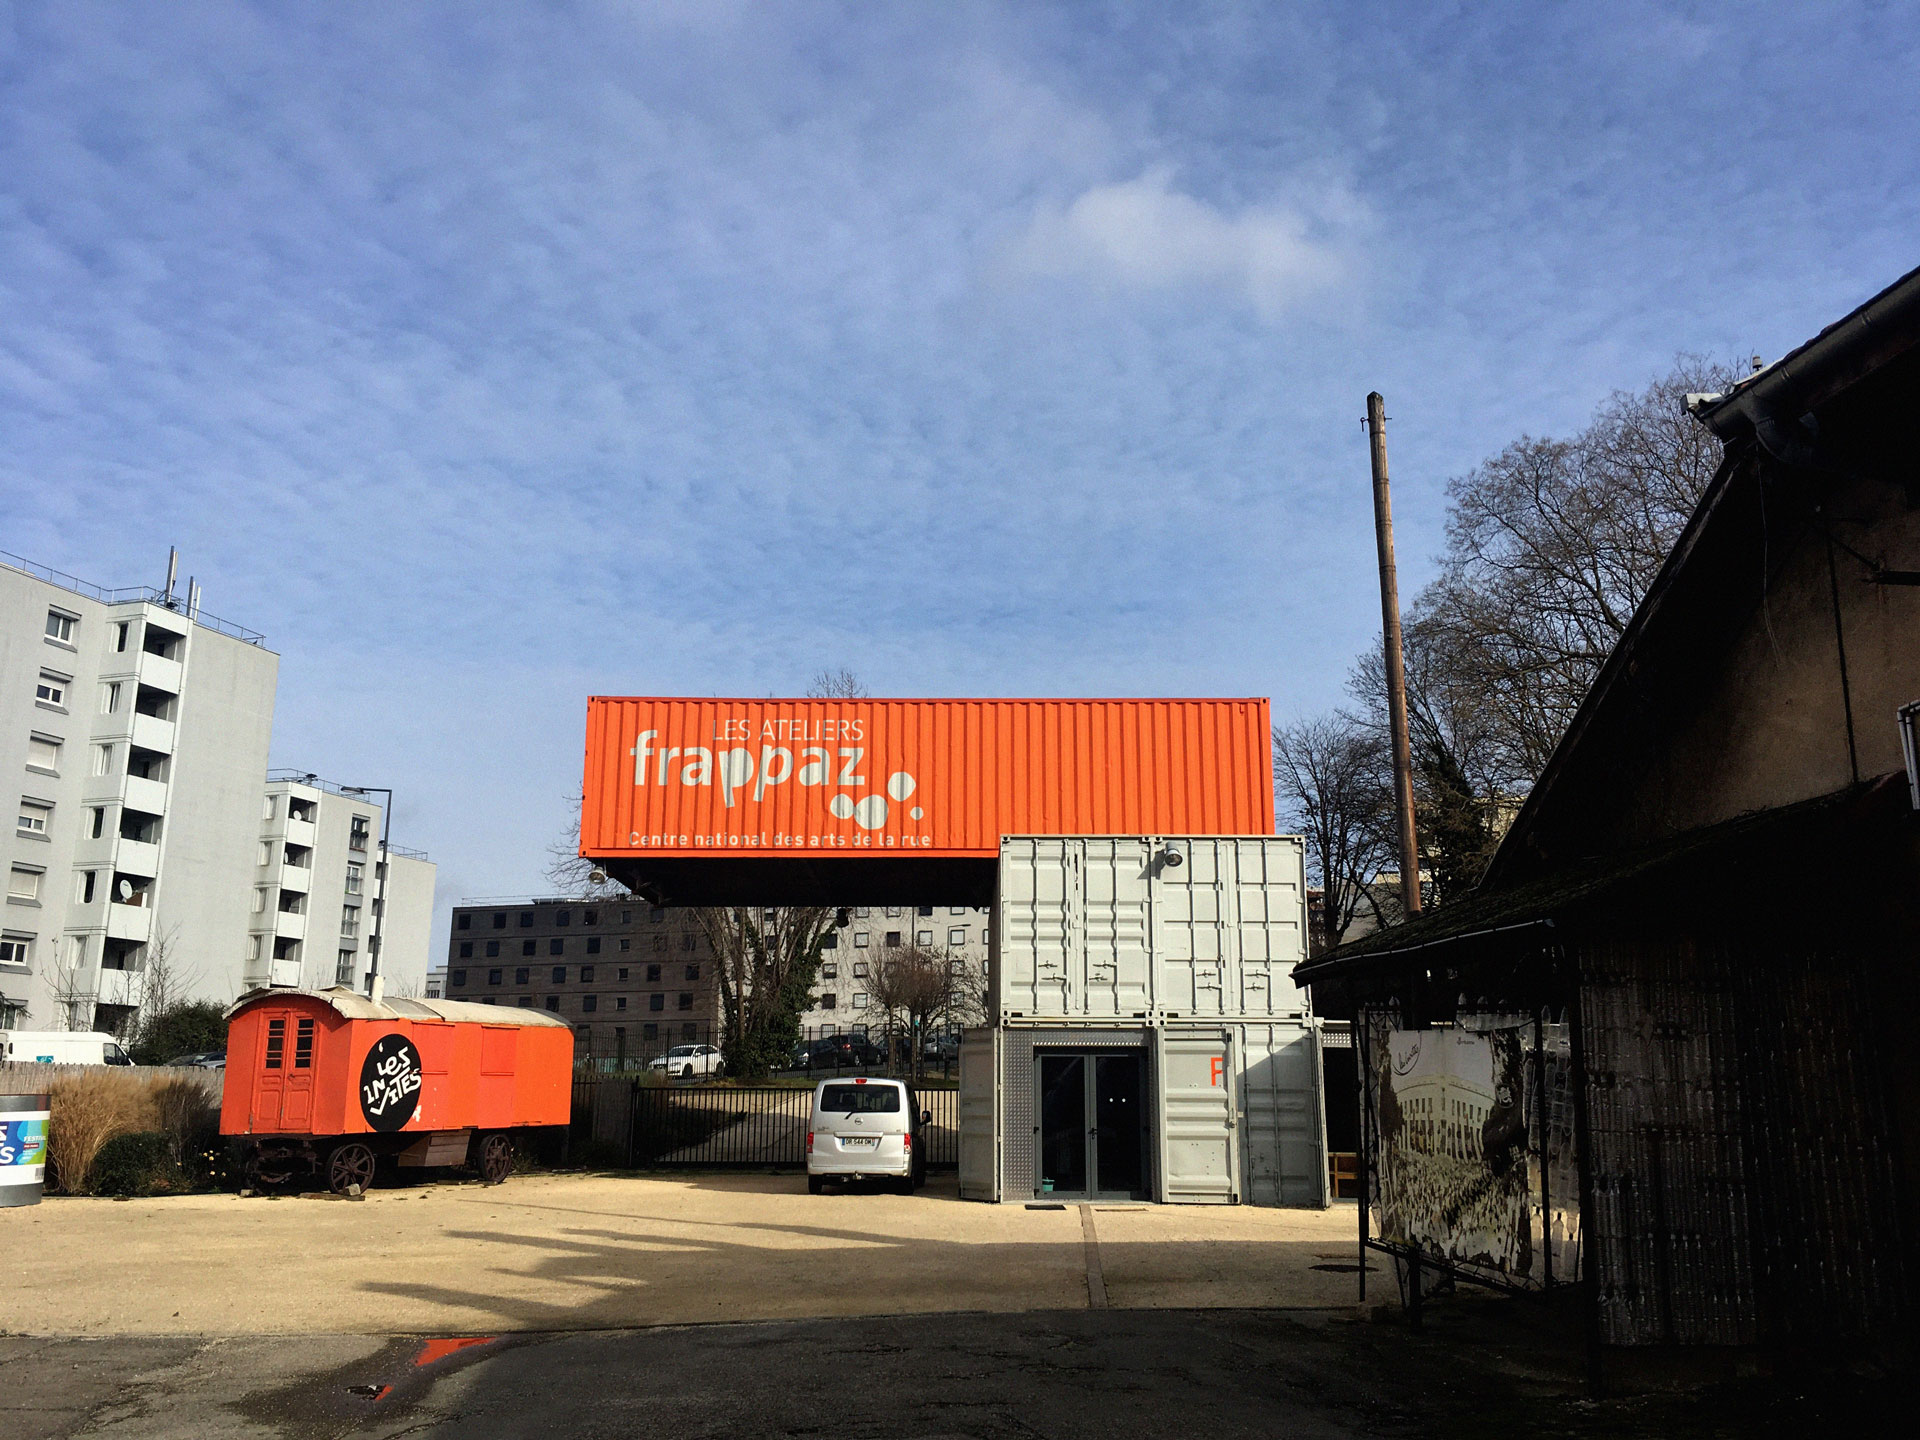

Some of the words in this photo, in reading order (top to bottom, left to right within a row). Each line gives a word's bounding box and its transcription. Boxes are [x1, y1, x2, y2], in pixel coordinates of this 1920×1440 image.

[712, 719, 751, 741] LES
[758, 719, 864, 741] ATELIERS
[630, 729, 865, 809] frappaz
[629, 831, 688, 846] Centre
[694, 831, 767, 846] national
[773, 832, 804, 846] des
[810, 833, 846, 846] arts
[852, 832, 873, 846] de
[879, 832, 895, 846] la
[901, 835, 931, 846] rue
